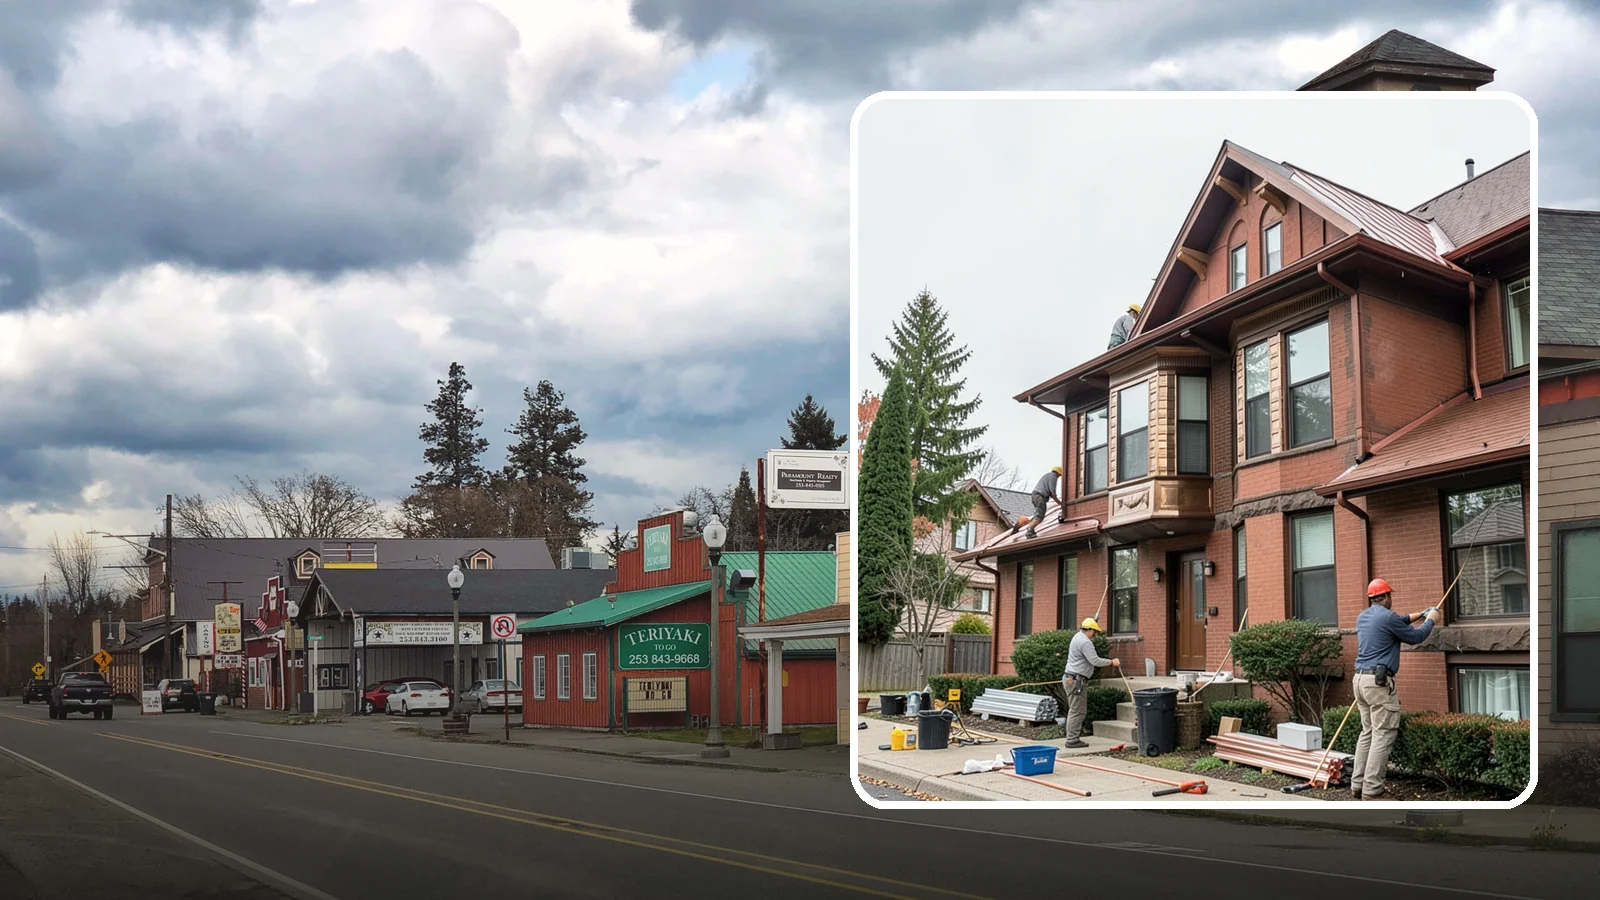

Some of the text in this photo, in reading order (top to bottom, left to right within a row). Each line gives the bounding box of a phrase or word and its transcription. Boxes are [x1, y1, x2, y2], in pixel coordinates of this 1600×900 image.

[781, 471, 838, 480] PARAMOUNT REALTY
[624, 627, 702, 646] TERIYAKI
[665, 643, 676, 651] GO
[628, 653, 700, 665] 253 843-9668
